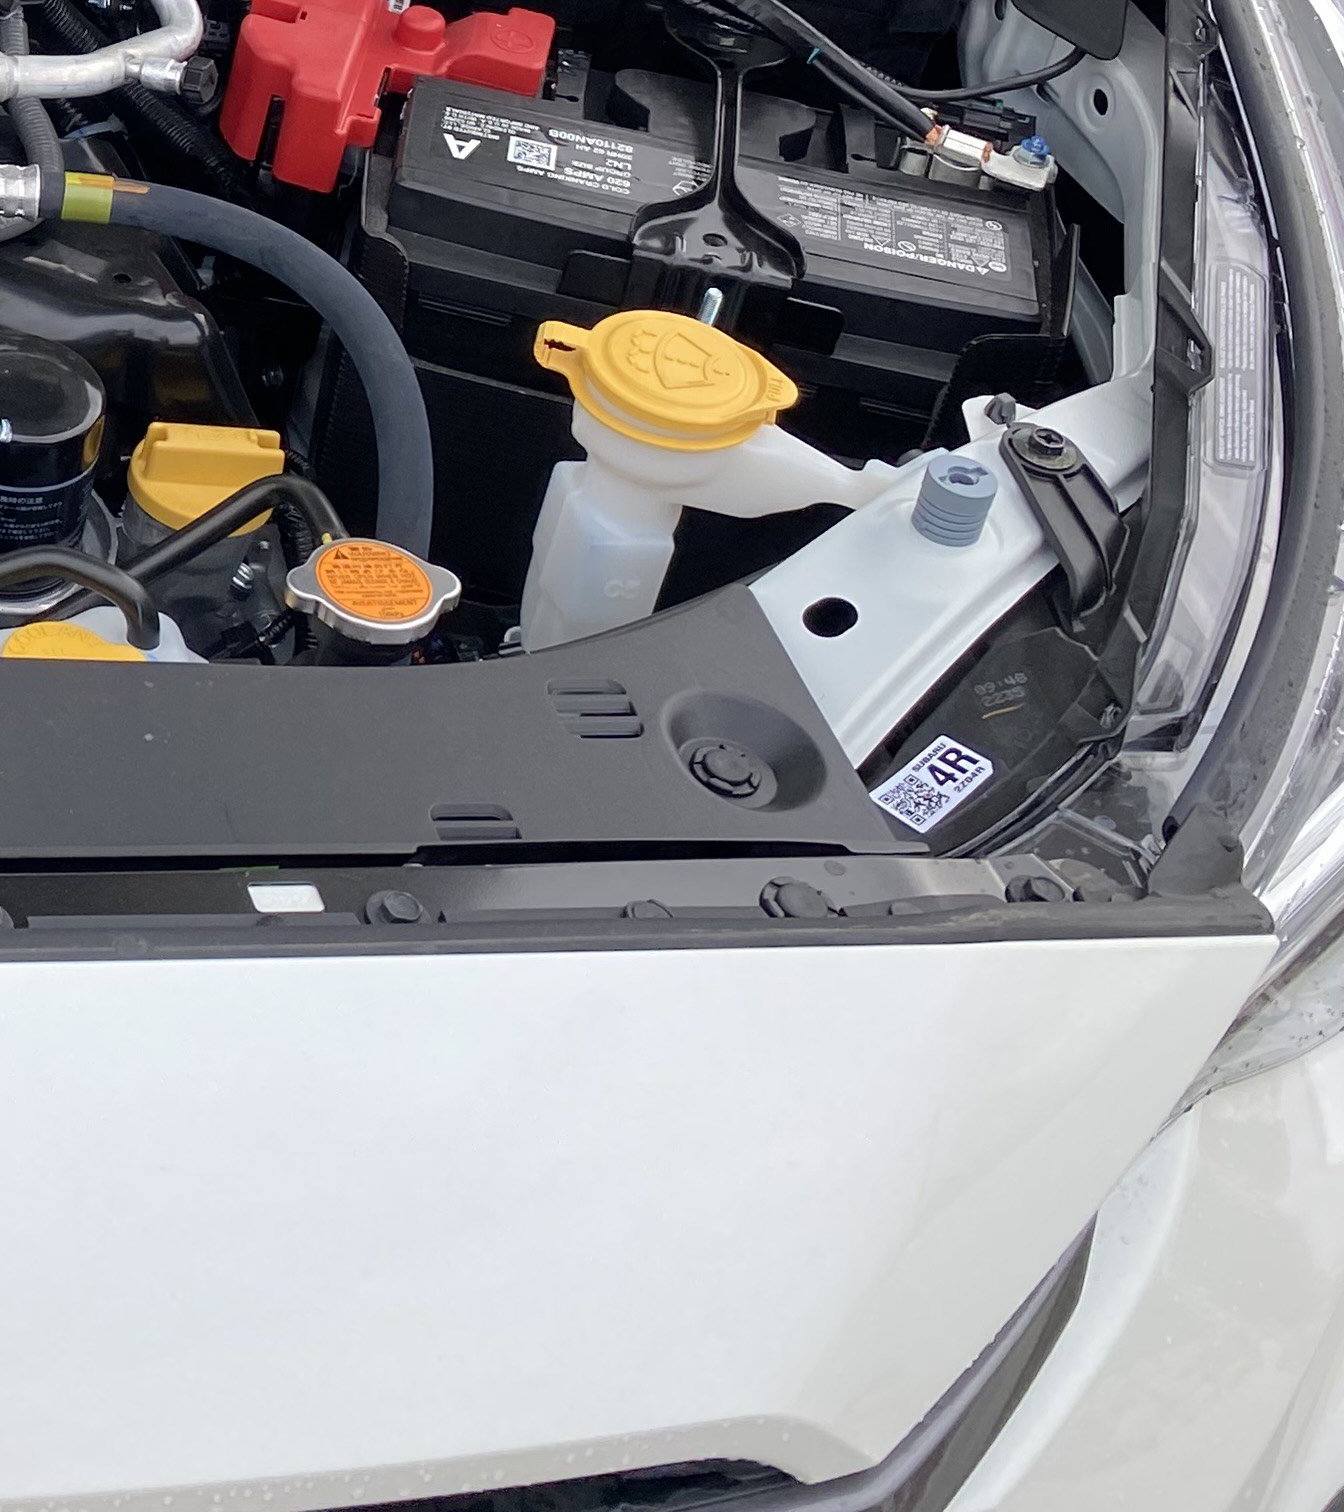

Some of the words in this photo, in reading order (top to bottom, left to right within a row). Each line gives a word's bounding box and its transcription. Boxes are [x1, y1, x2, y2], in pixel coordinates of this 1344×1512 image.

[442, 132, 481, 160] A
[548, 129, 633, 153] 82110AN00B
[516, 165, 545, 176] AMPS
[594, 166, 631, 178] GROUP
[605, 158, 631, 171] LN2
[546, 172, 600, 188] CRANKING
[563, 167, 604, 182] AMPS
[606, 176, 631, 188] 620
[601, 183, 630, 194] COLD
[863, 242, 975, 273] DANGER/POISON
[912, 742, 947, 772] SUBARU
[927, 747, 980, 786] 4R
